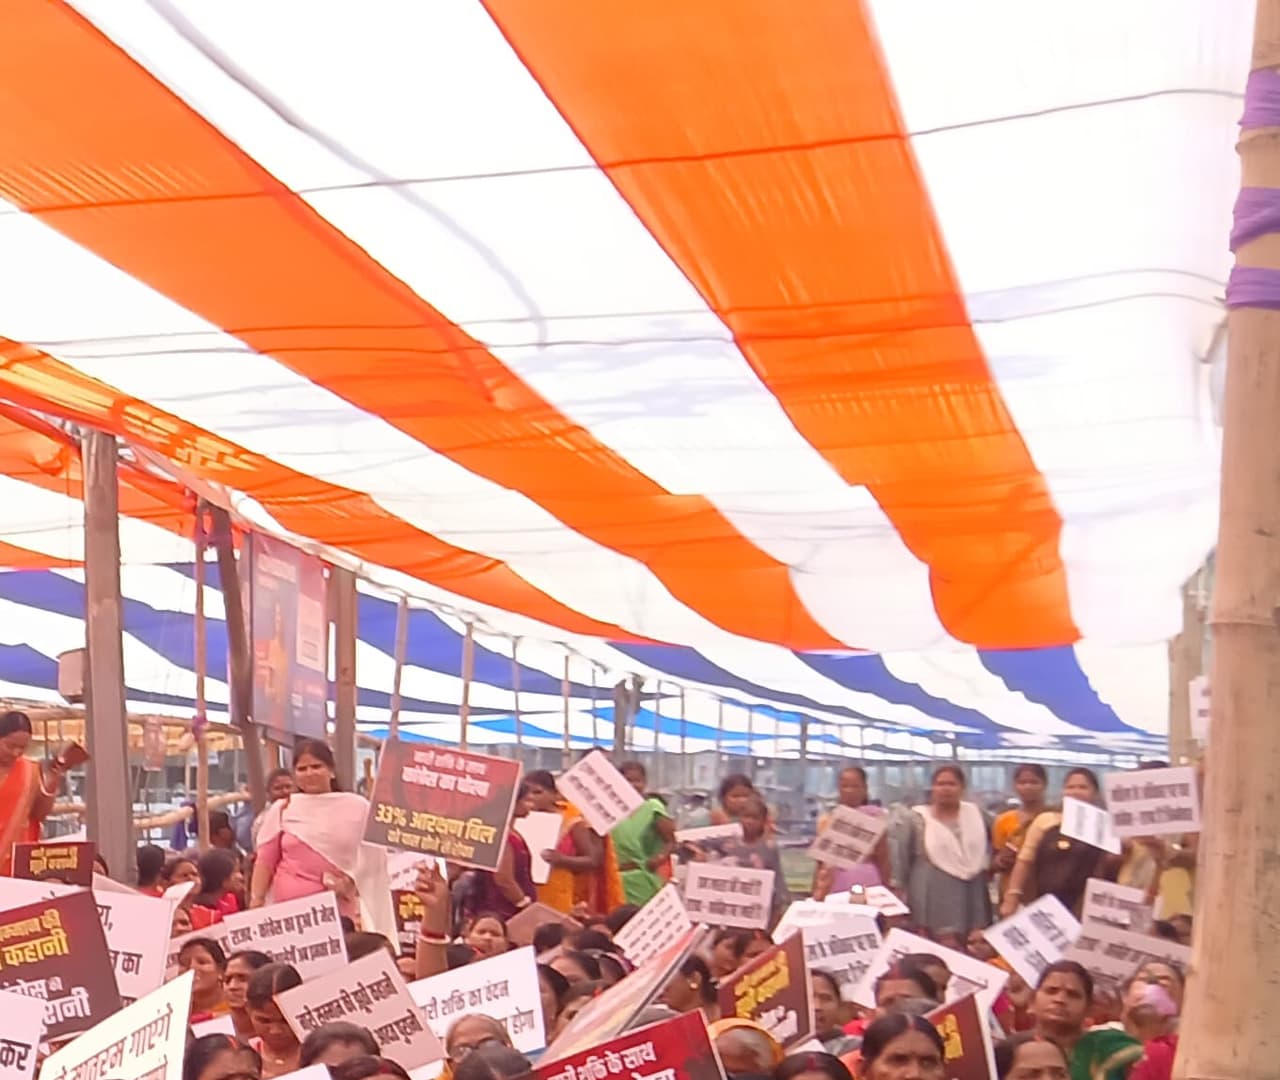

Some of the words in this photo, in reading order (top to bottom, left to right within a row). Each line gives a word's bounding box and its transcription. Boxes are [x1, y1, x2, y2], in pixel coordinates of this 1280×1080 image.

[374, 803, 407, 827] 33%
[409, 811, 465, 838] आरक्षण
[465, 818, 497, 844] बिल
[2, 929, 69, 965] कहानी
[122, 950, 142, 974] का
[468, 988, 482, 1006] का
[0, 1039, 31, 1071] कर
[605, 1051, 624, 1074] के
[623, 1041, 657, 1068] साथ
